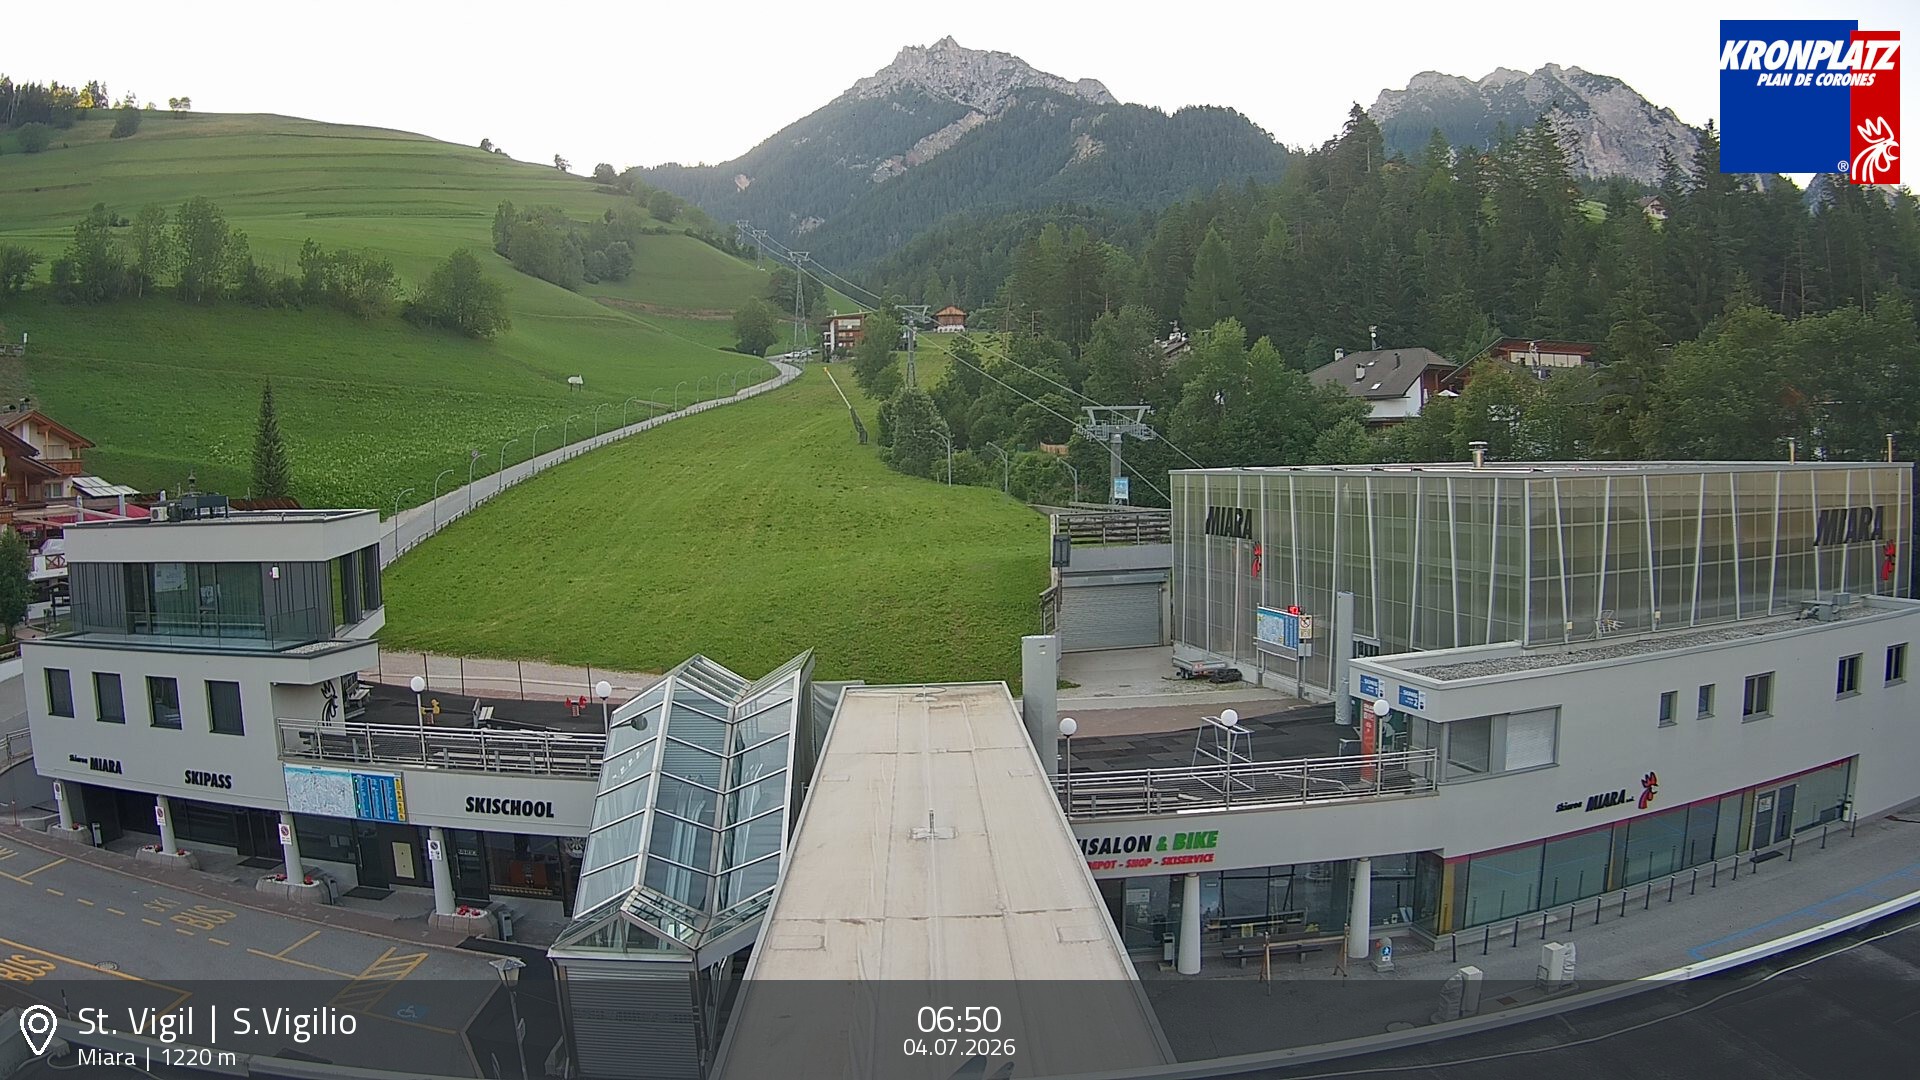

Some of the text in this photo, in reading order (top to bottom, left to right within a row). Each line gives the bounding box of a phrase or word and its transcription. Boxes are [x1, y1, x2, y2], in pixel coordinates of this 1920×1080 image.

[1205, 506, 1252, 539] MIARA
[1813, 505, 1884, 546] MIARA
[90, 757, 122, 775] MIARA
[184, 770, 232, 790] SKIPASS
[466, 796, 554, 818] SKISCHOOL
[1585, 789, 1626, 812] MIARA
[1156, 836, 1168, 852] &
[1172, 830, 1219, 850] BIKE
[1125, 858, 1152, 868] SHOP
[1161, 853, 1214, 866] SKISERVICE
[169, 905, 237, 931] BUS
